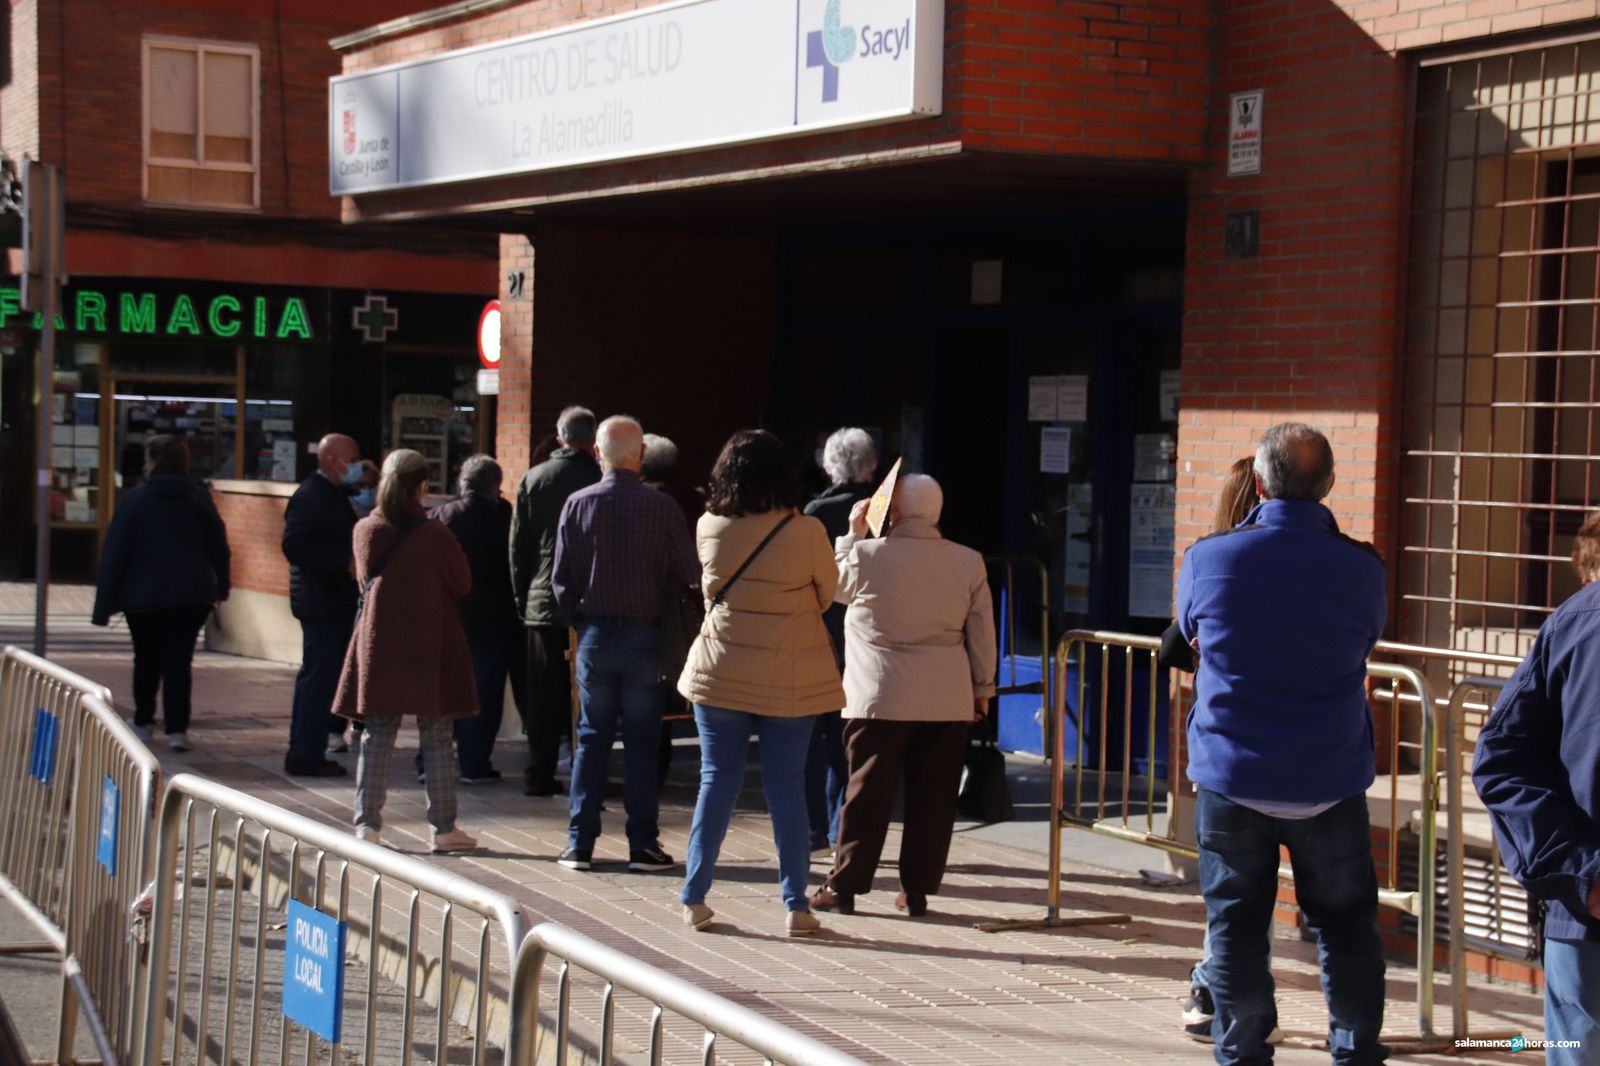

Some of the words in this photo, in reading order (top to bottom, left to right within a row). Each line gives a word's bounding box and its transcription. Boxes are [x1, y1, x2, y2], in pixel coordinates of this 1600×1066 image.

[860, 18, 910, 61] Sacyl
[474, 47, 560, 108] CENTRO
[567, 39, 597, 92] DE
[604, 20, 683, 84] SALUD
[380, 135, 390, 151] de
[511, 118, 532, 159] La
[539, 99, 634, 154] Alamedilla
[295, 917, 329, 959] POLICIA
[294, 953, 324, 994] LOCAL
